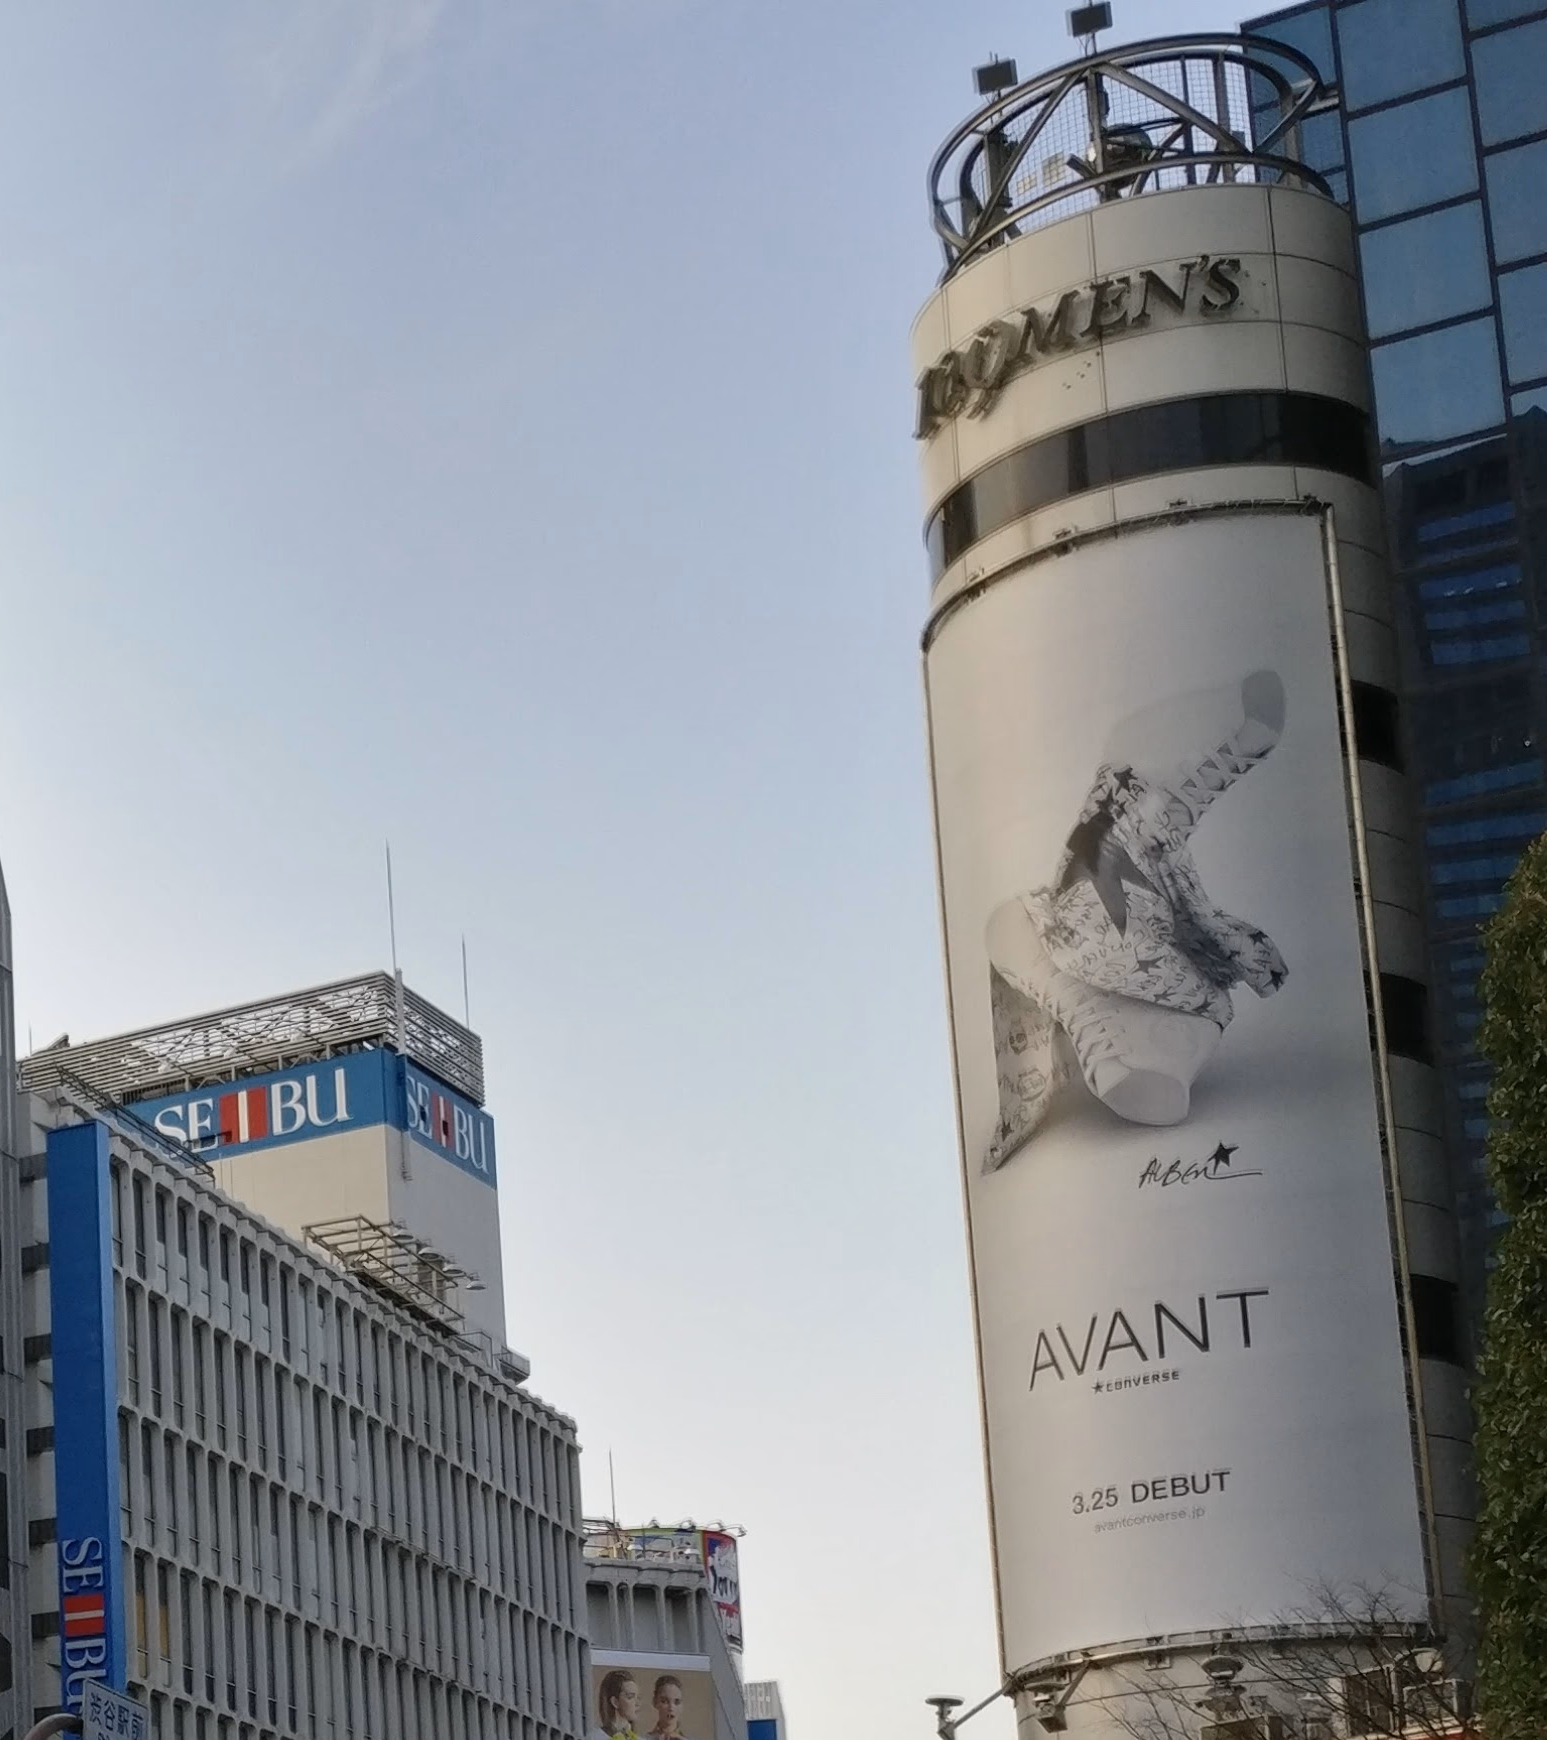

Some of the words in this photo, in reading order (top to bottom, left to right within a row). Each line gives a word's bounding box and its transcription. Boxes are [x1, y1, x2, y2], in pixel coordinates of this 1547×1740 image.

[154, 1068, 353, 1155] SEIBU
[406, 1075, 490, 1175] SEIBU
[1029, 1287, 1269, 1391] AVANT
[1071, 1487, 1119, 1515] 3.25
[1130, 1468, 1231, 1504] DEBUT
[1094, 1506, 1205, 1534] avantconverse.jp
